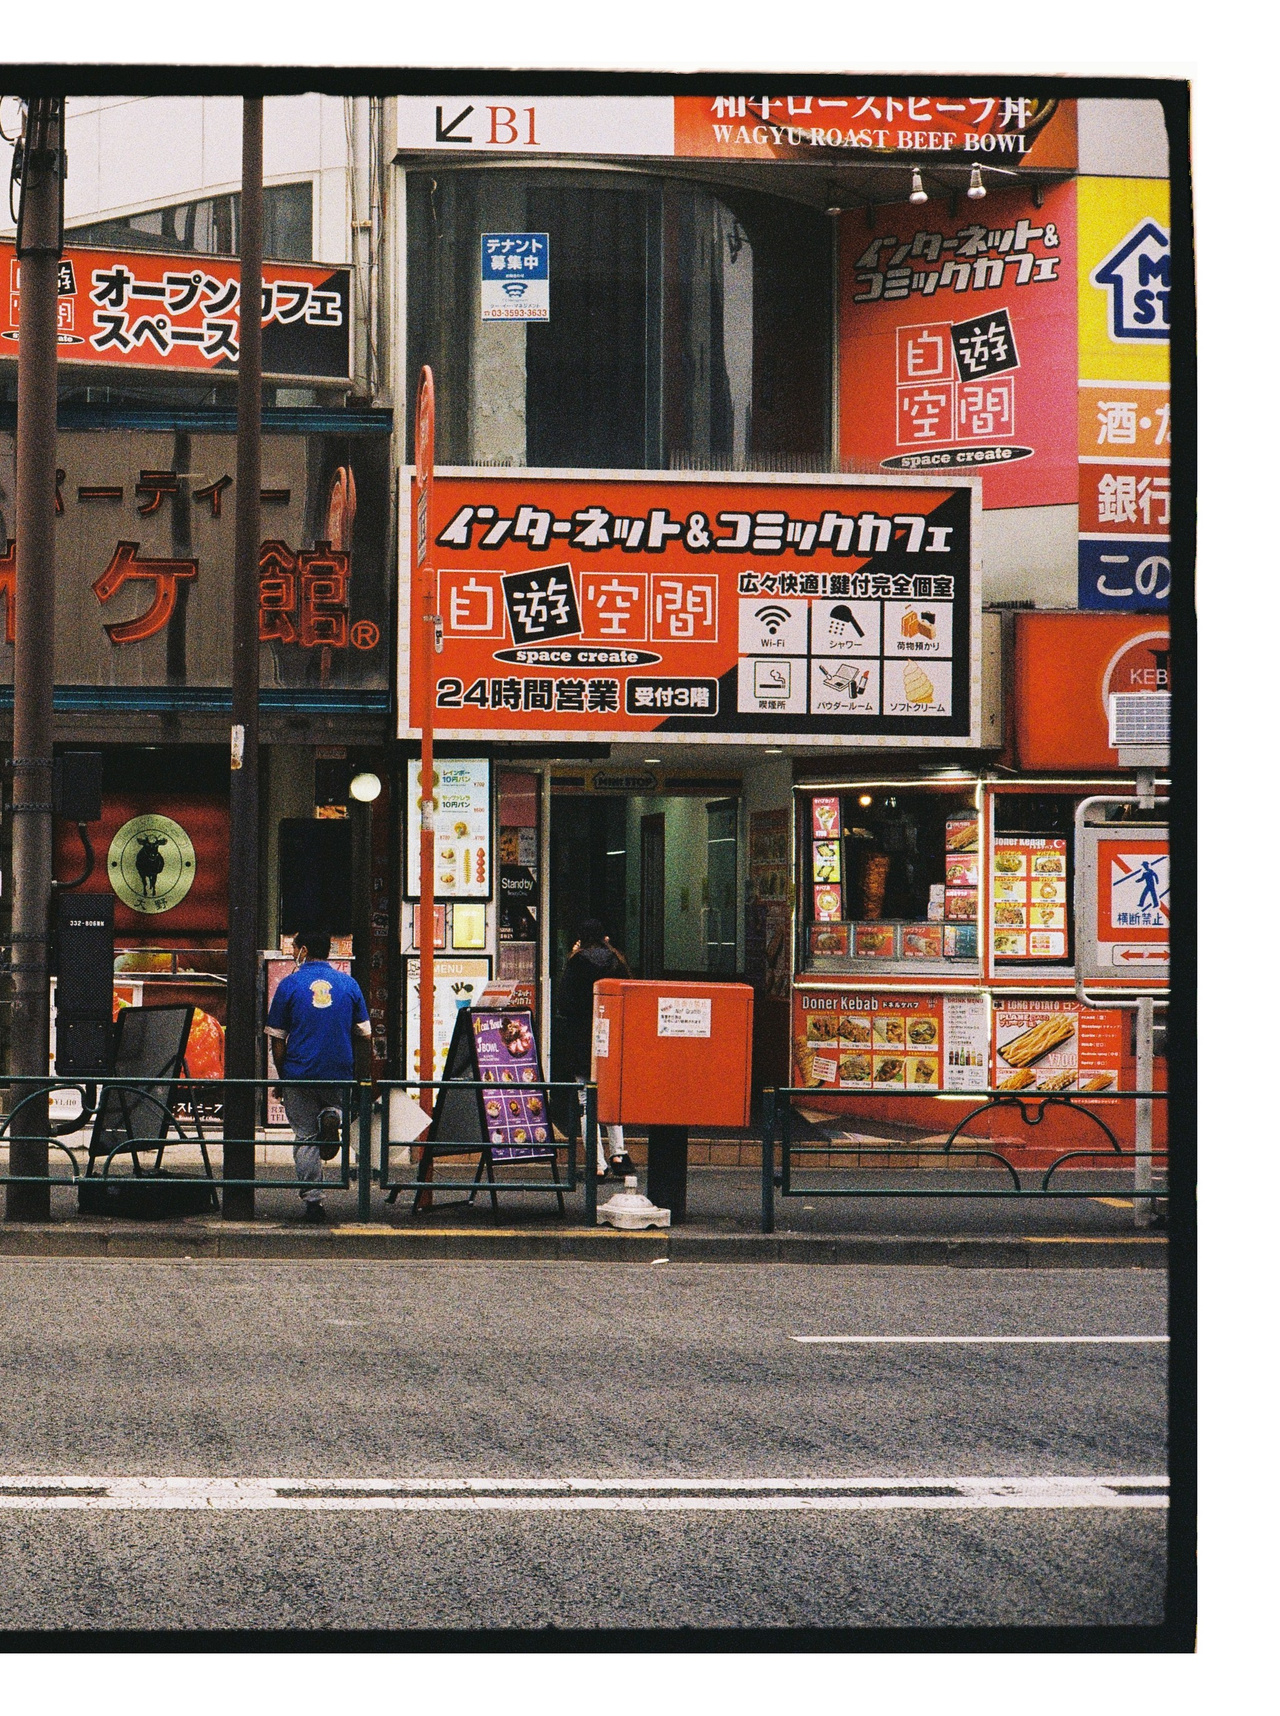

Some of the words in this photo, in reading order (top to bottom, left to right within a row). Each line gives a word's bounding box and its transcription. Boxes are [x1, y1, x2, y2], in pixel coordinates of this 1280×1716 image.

[485, 106, 540, 145] B1
[712, 124, 804, 146] WAGYU
[810, 127, 889, 149] ROAST
[897, 130, 957, 151] BEEF
[963, 133, 1033, 153] BOWL
[487, 239, 543, 253] テナント
[853, 219, 1061, 268] インターネット&
[491, 255, 538, 270] 募集中
[853, 253, 1061, 302] コミックカフェ
[93, 314, 240, 357] スペース
[900, 313, 1014, 380] 自遊
[899, 384, 1013, 441] 空間
[902, 452, 950, 468] space
[956, 447, 1012, 462] create
[438, 507, 954, 553] インターネット&コミックカフェ
[1097, 555, 1170, 598] この
[444, 570, 716, 640] 自遊空間
[761, 639, 785, 648] Wi-Fi
[829, 640, 862, 649] シャワー
[896, 641, 940, 651] 荷物預かり
[516, 650, 571, 664] space
[578, 650, 638, 663] create
[436, 678, 620, 713] 24時間営業
[634, 687, 711, 708] 受付3階
[758, 701, 786, 710] 喫煙所
[817, 702, 873, 711] パウダールーム
[890, 703, 945, 712] ソフトクリーム
[1117, 912, 1163, 926] 横断禁止
[433, 965, 463, 973] MENU
[802, 996, 838, 1010] Doner
[841, 996, 879, 1010] Kebab
[1008, 1001, 1028, 1010] LONG
[1030, 1001, 1060, 1010] POTATO
